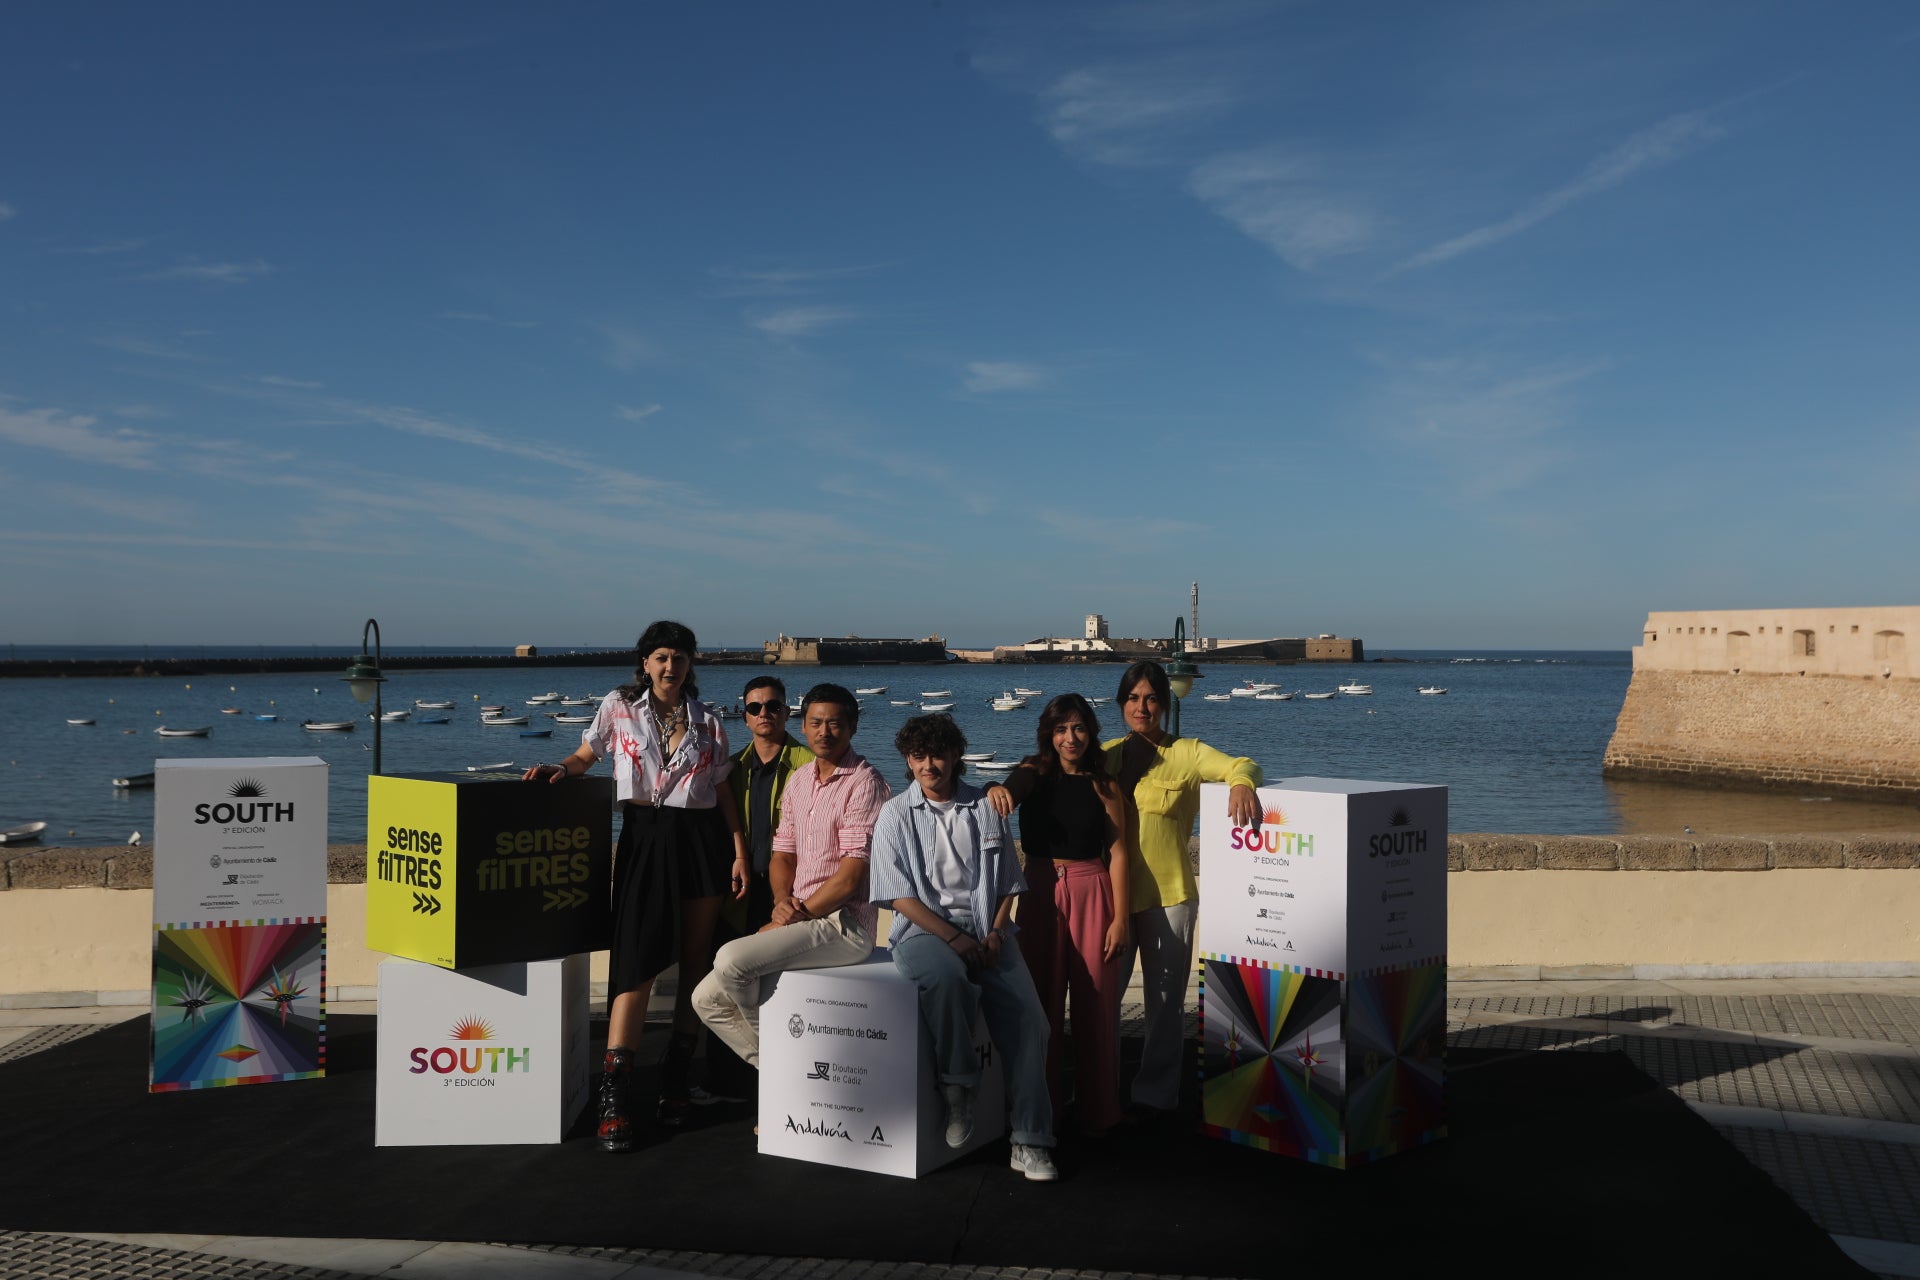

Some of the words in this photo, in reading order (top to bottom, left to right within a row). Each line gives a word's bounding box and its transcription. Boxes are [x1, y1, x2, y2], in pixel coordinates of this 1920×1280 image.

[194, 802, 294, 824] SOUTH
[232, 826, 265, 834] EDICIÓN
[387, 826, 442, 855] sense
[496, 826, 590, 855] sense
[1231, 827, 1314, 857] SOUTH
[1369, 830, 1427, 858] SOUTH
[1261, 857, 1290, 867] EDICIÓN
[828, 1000, 868, 1009] ORGANIZATIONS
[807, 1023, 855, 1037] Ayuntamiento
[855, 1028, 865, 1038] de
[866, 1028, 888, 1041] Cádiz
[409, 1047, 530, 1074] SOUTH
[832, 1063, 868, 1075] Diputación
[454, 1077, 495, 1087] EDICIÓN
[832, 1074, 841, 1082] de
[842, 1076, 862, 1085] Cádiz
[834, 1104, 856, 1113] SUPPORT
[785, 1114, 854, 1142] Andalucía
